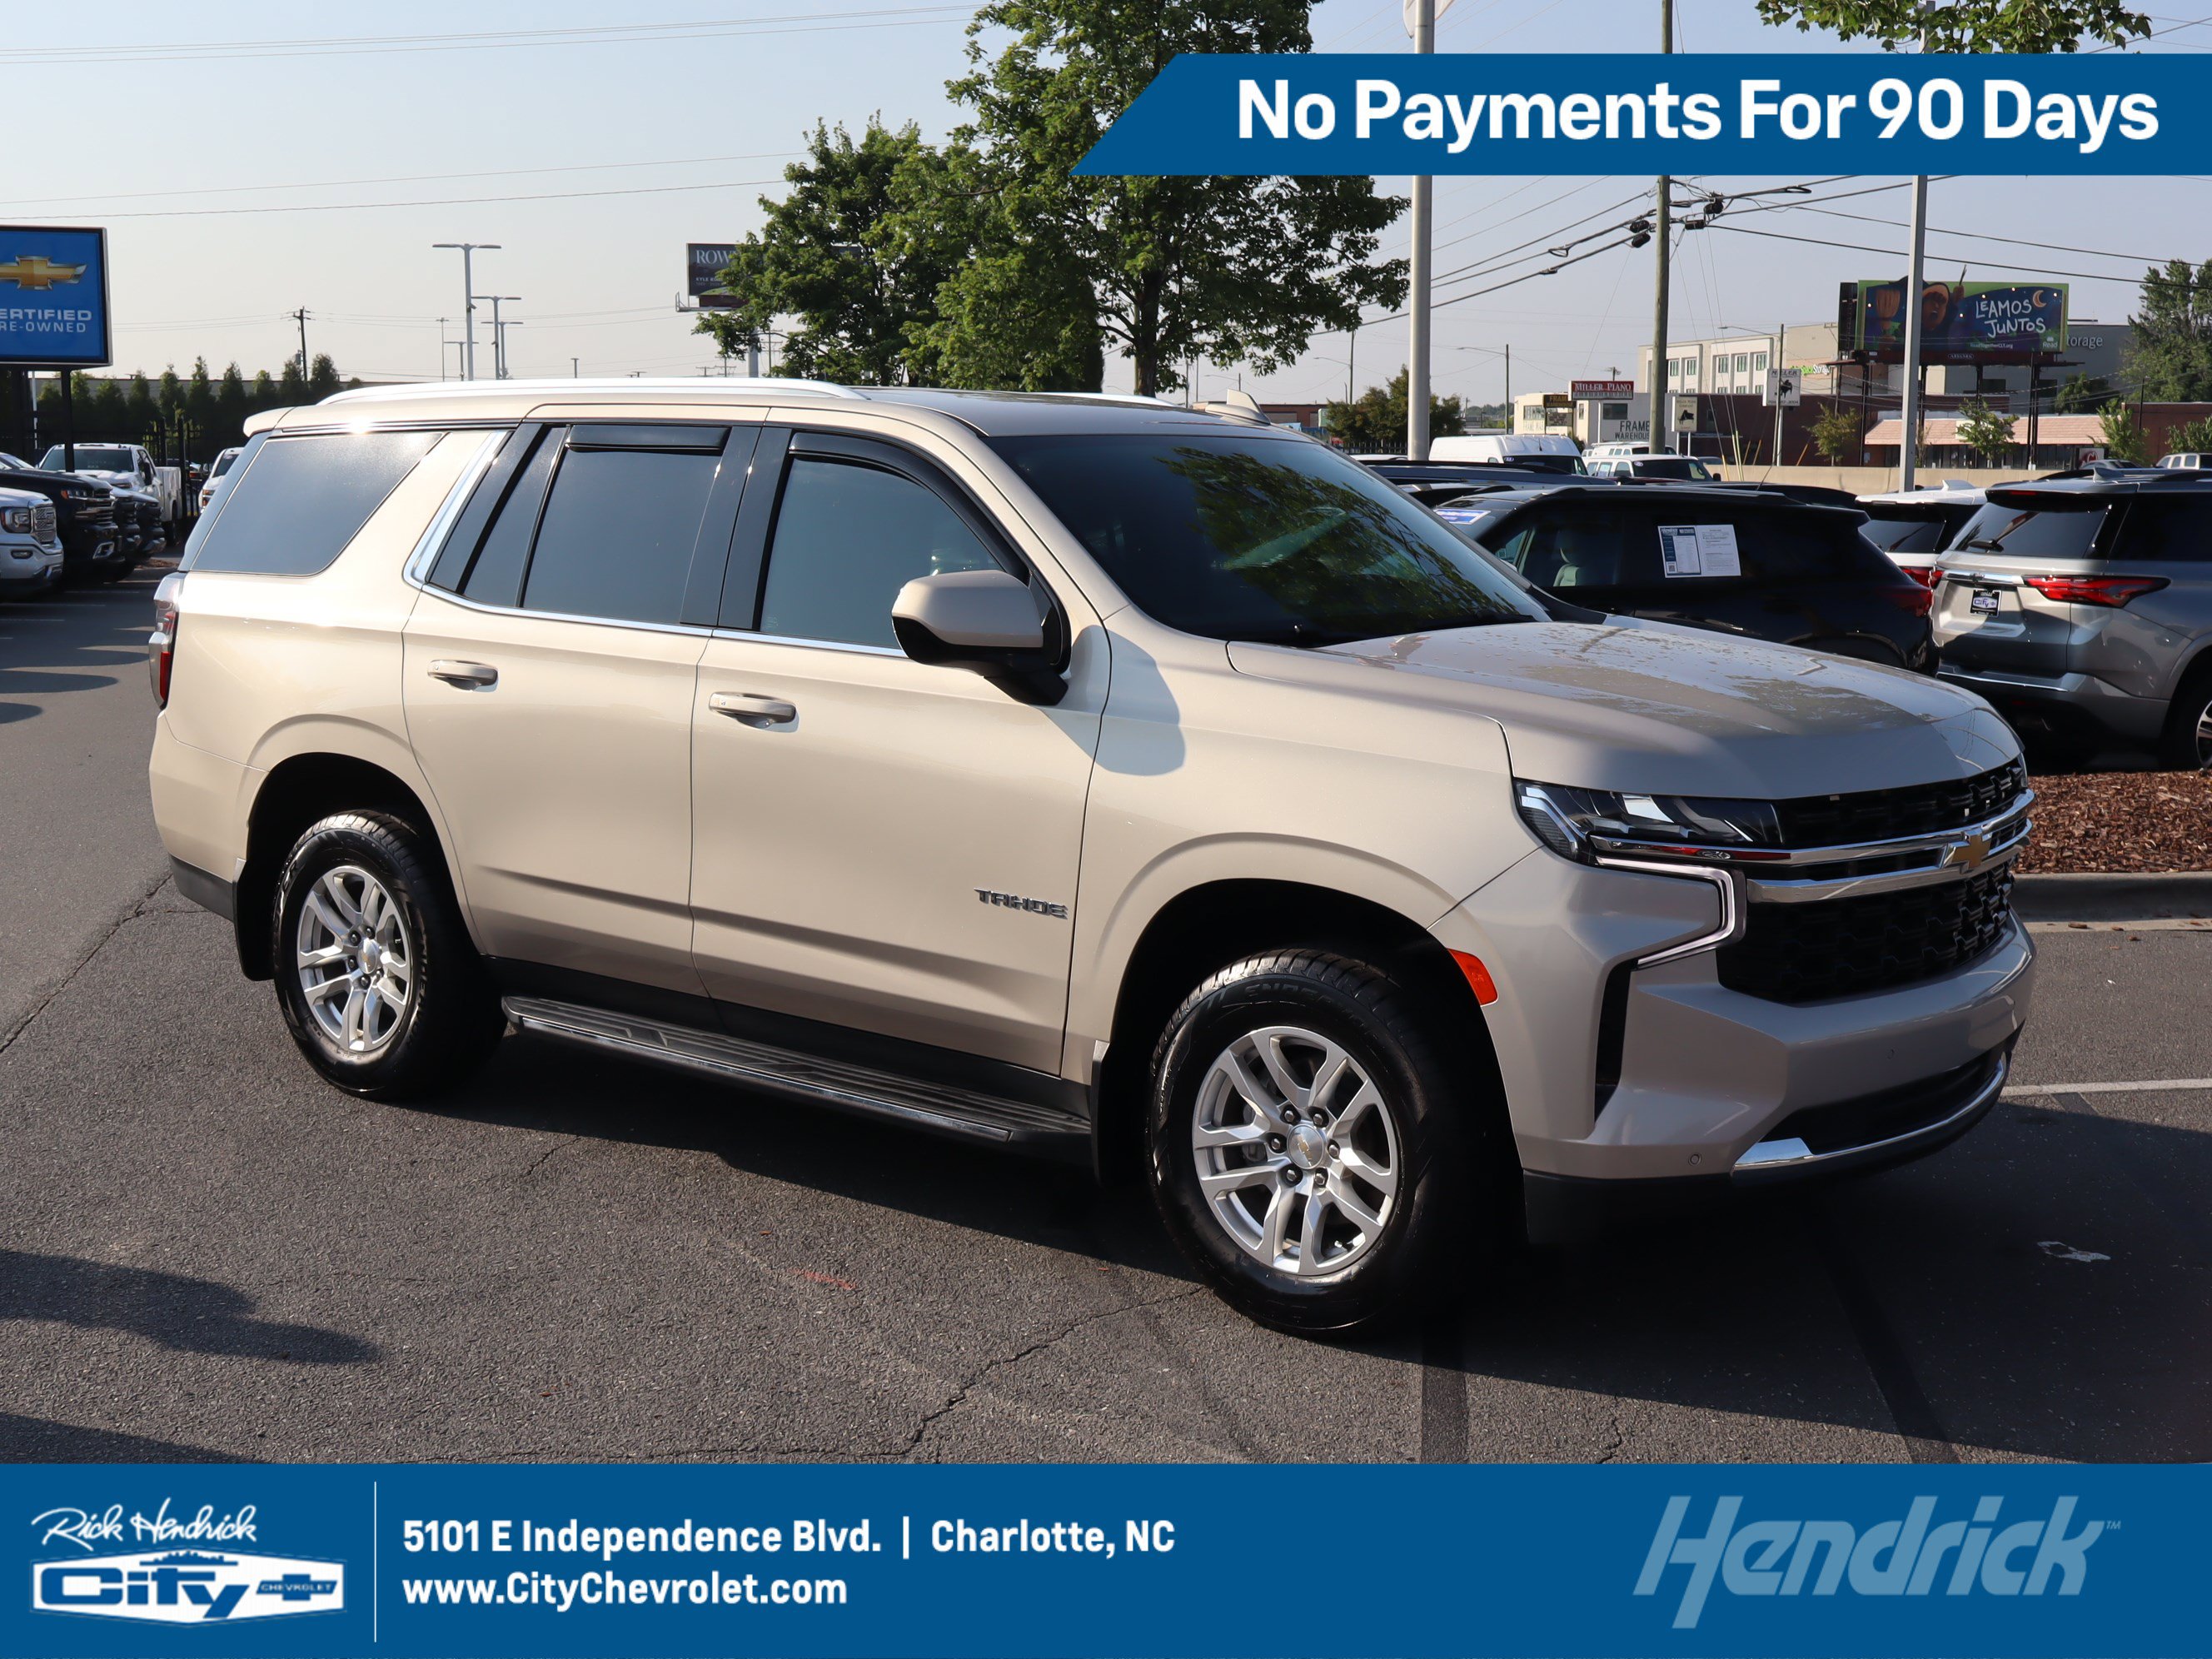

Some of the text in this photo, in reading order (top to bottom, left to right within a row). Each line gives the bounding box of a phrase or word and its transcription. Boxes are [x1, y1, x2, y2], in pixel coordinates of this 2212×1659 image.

[696, 249, 737, 264] ROW
[0, 308, 92, 321] ERTIFIED
[0, 321, 86, 332] RE-OWNED
[2066, 335, 2104, 349] torage
[1574, 382, 1632, 391] MILLER PIANO
[1620, 421, 1650, 431] FRAME
[974, 888, 1069, 919] TAHOE
